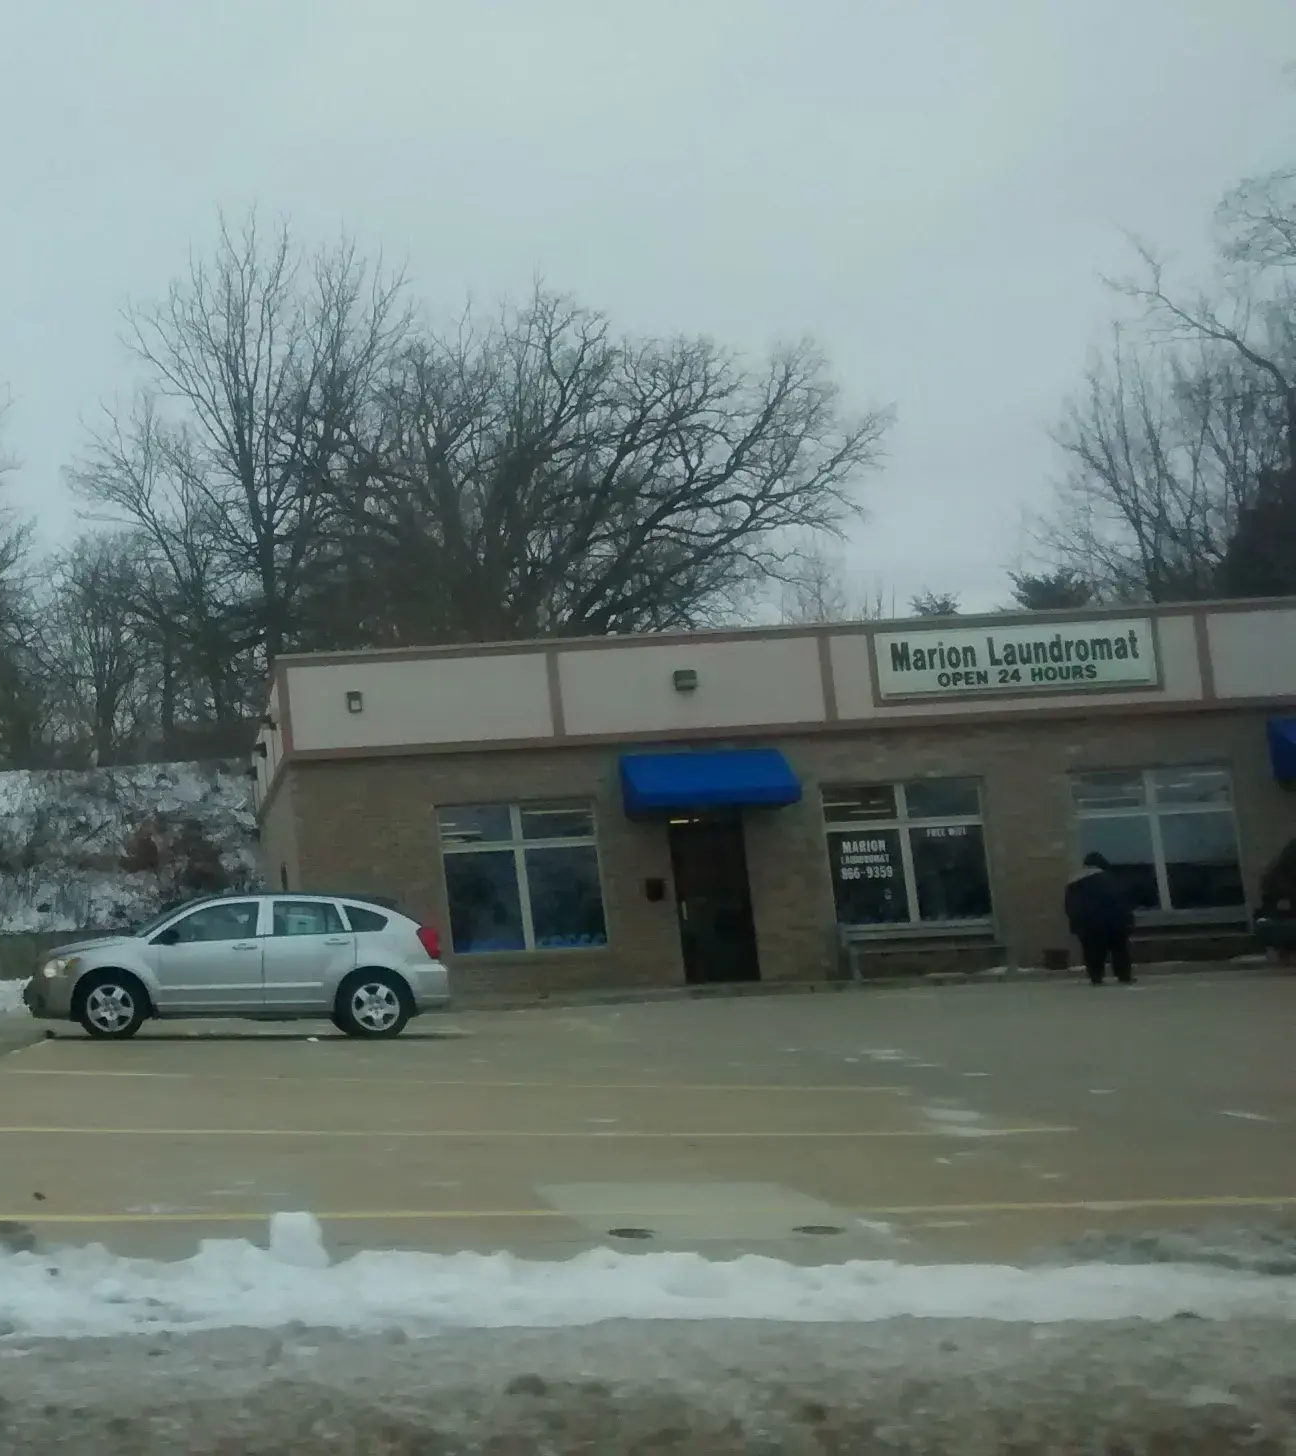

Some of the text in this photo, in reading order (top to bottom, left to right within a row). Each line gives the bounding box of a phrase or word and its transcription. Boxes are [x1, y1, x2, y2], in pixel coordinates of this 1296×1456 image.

[890, 629, 1140, 672] Marion Laundromat
[937, 664, 1098, 688] OPEN 24 HOURS
[842, 839, 887, 854] MARION
